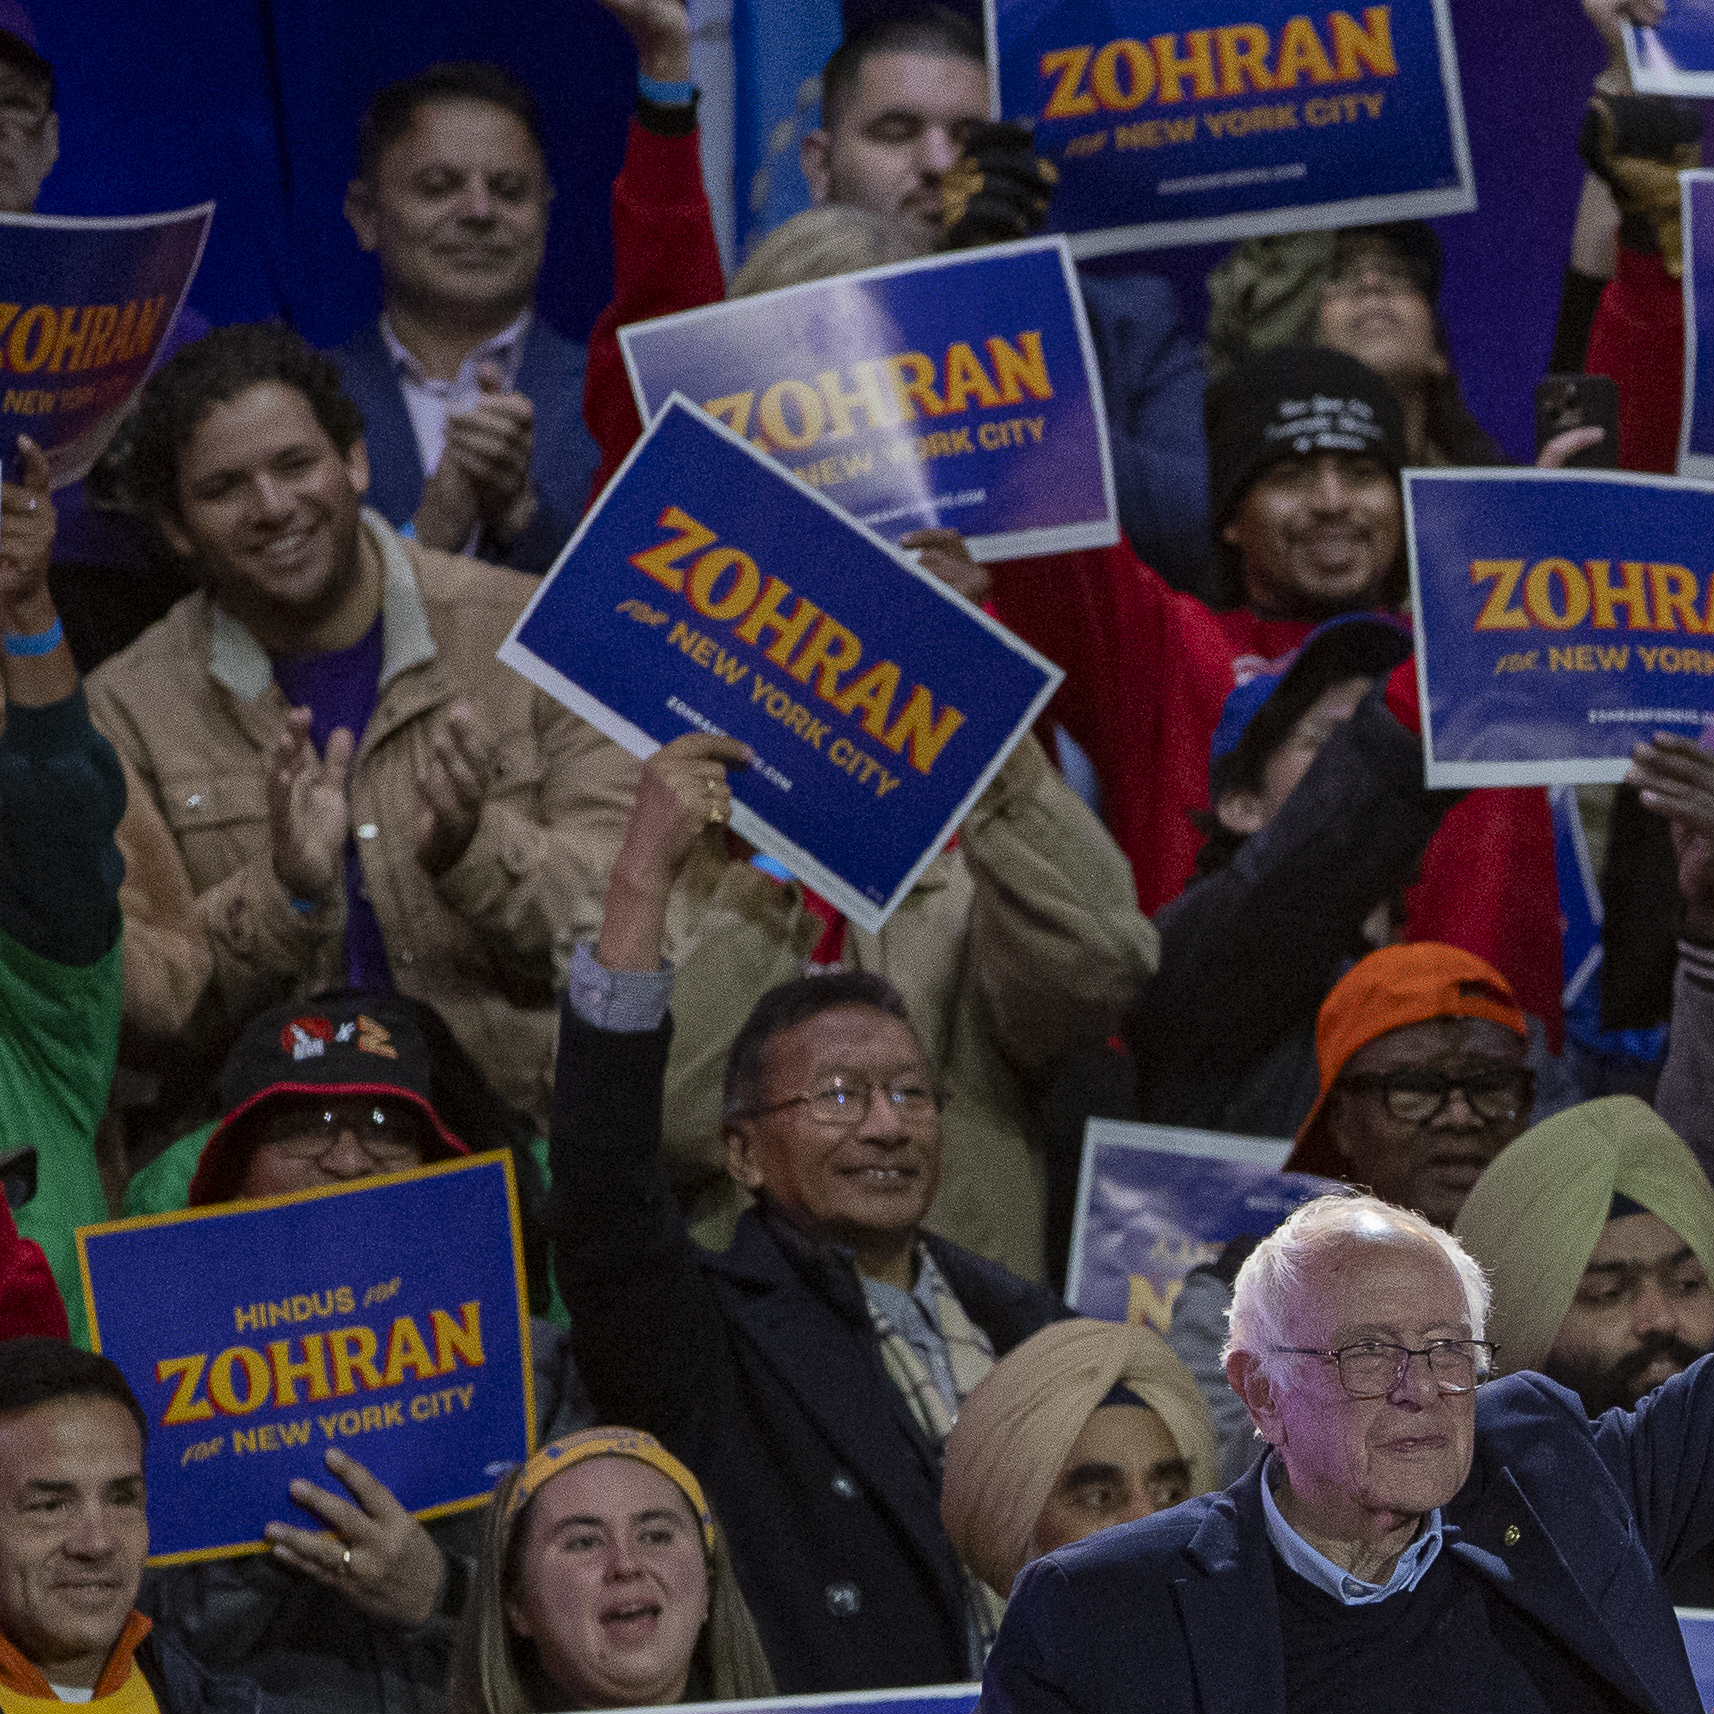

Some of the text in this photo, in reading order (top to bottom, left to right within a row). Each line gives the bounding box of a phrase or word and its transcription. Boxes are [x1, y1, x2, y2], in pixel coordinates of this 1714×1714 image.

[1040, 5, 1398, 120] ZOHRAN
[1115, 115, 1197, 151] NEW
[1205, 104, 1299, 138] YORK
[1304, 92, 1385, 128] CITY
[977, 416, 1045, 452] CITY
[628, 506, 968, 776] ZOHRAN
[1548, 645, 1631, 672] NEW
[667, 622, 750, 685] NEW
[751, 675, 831, 749] YORK
[828, 737, 900, 798] CITY
[233, 1285, 356, 1333] HINDUS
[154, 1300, 486, 1427] ZOHRAN
[232, 1419, 311, 1456] NEW
[318, 1401, 404, 1439] YORK
[409, 1383, 475, 1422] CITY
